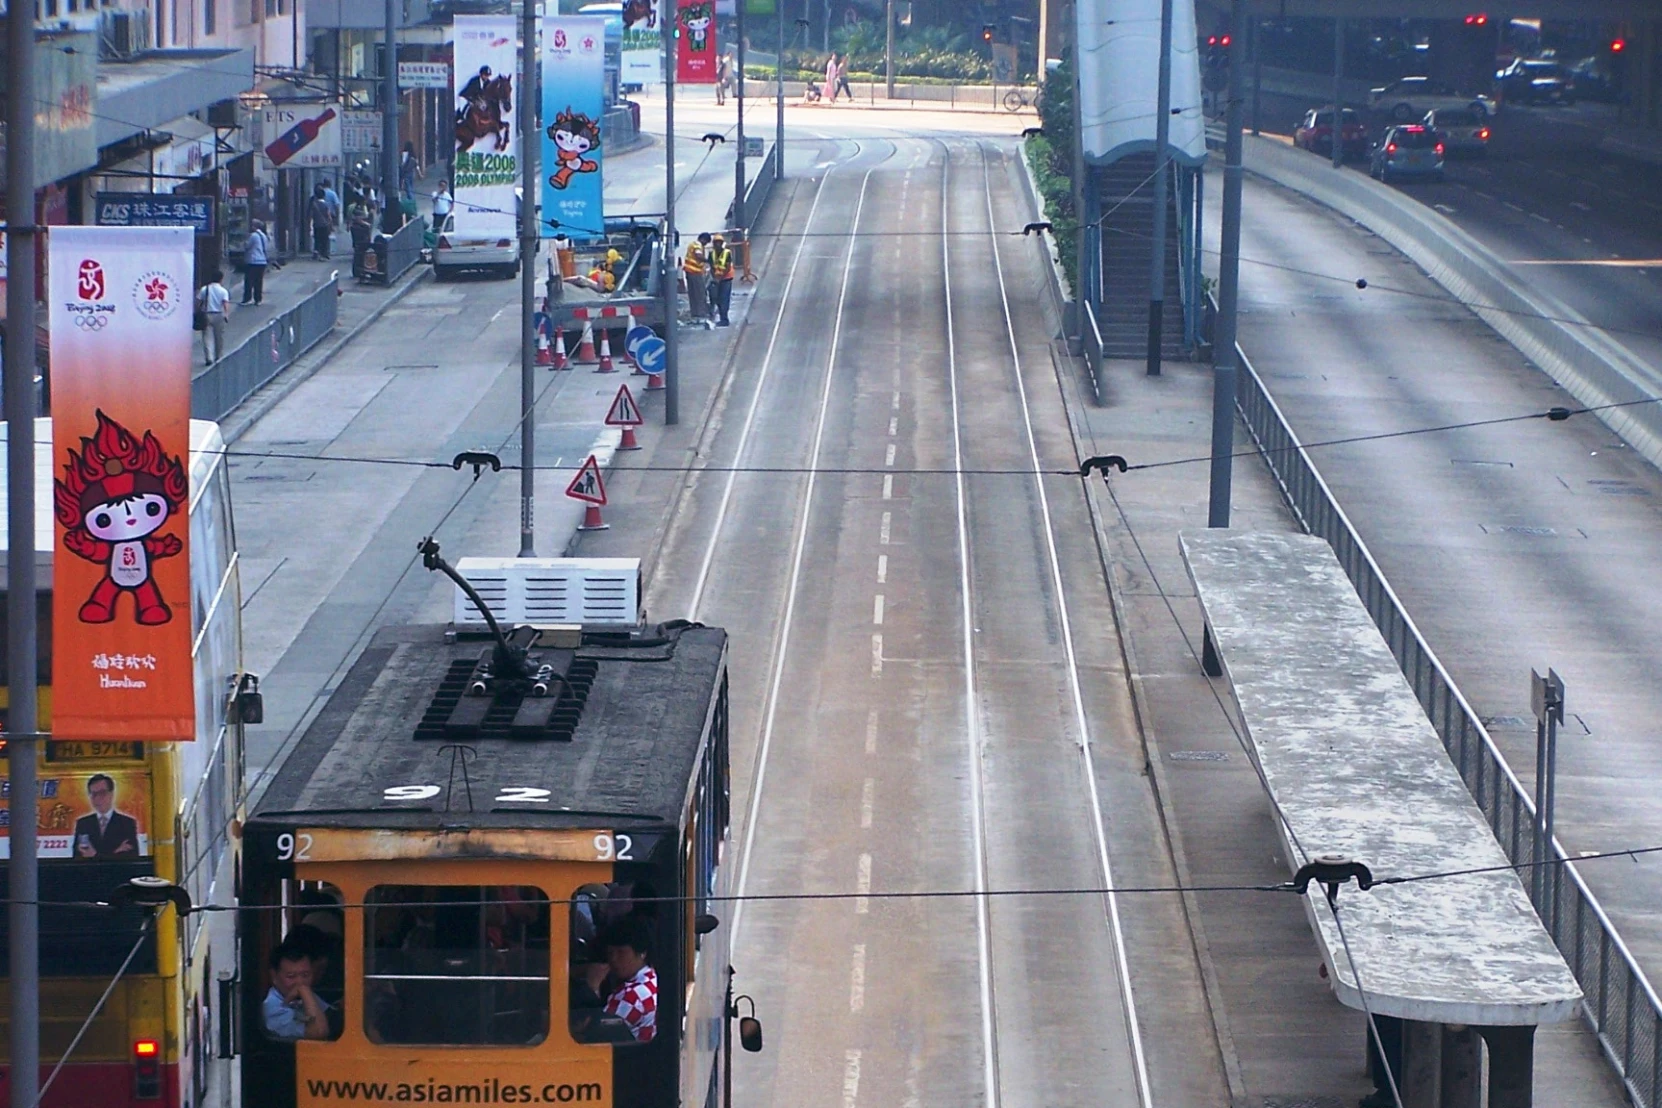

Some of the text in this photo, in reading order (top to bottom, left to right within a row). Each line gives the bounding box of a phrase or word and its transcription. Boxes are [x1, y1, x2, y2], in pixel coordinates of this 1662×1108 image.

[101, 202, 207, 218] CKS 珠江客運
[65, 303, 94, 314] Beijing
[63, 741, 84, 756] HA
[276, 833, 314, 861] 92
[592, 834, 634, 861] 92
[307, 1077, 602, 1103] www.asiamiles.com
